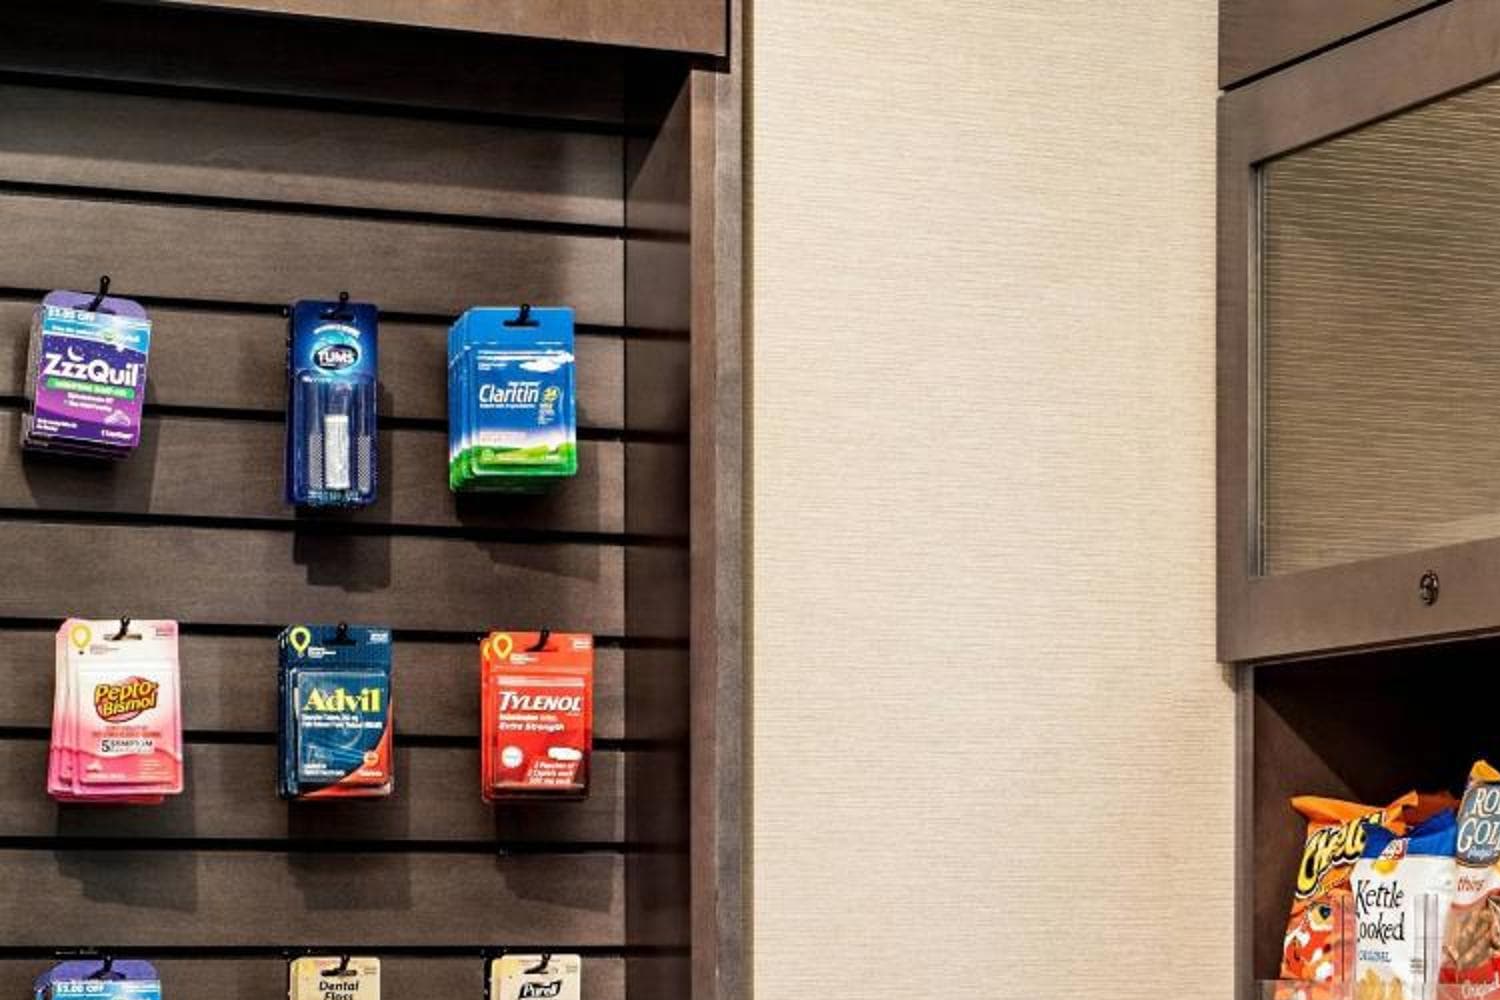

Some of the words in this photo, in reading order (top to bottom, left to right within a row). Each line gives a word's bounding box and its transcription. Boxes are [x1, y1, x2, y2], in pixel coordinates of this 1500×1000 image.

[318, 349, 355, 364] TUMS
[44, 353, 139, 387] ZzzQuil
[479, 381, 540, 403] Claritin
[103, 694, 155, 716] Bismol
[303, 687, 381, 713] Advil
[499, 691, 581, 712] TYLENOL
[1297, 812, 1381, 893] Cheet
[1355, 879, 1405, 916] Kettle
[1356, 911, 1405, 945] ooked
[319, 980, 359, 991] Dental
